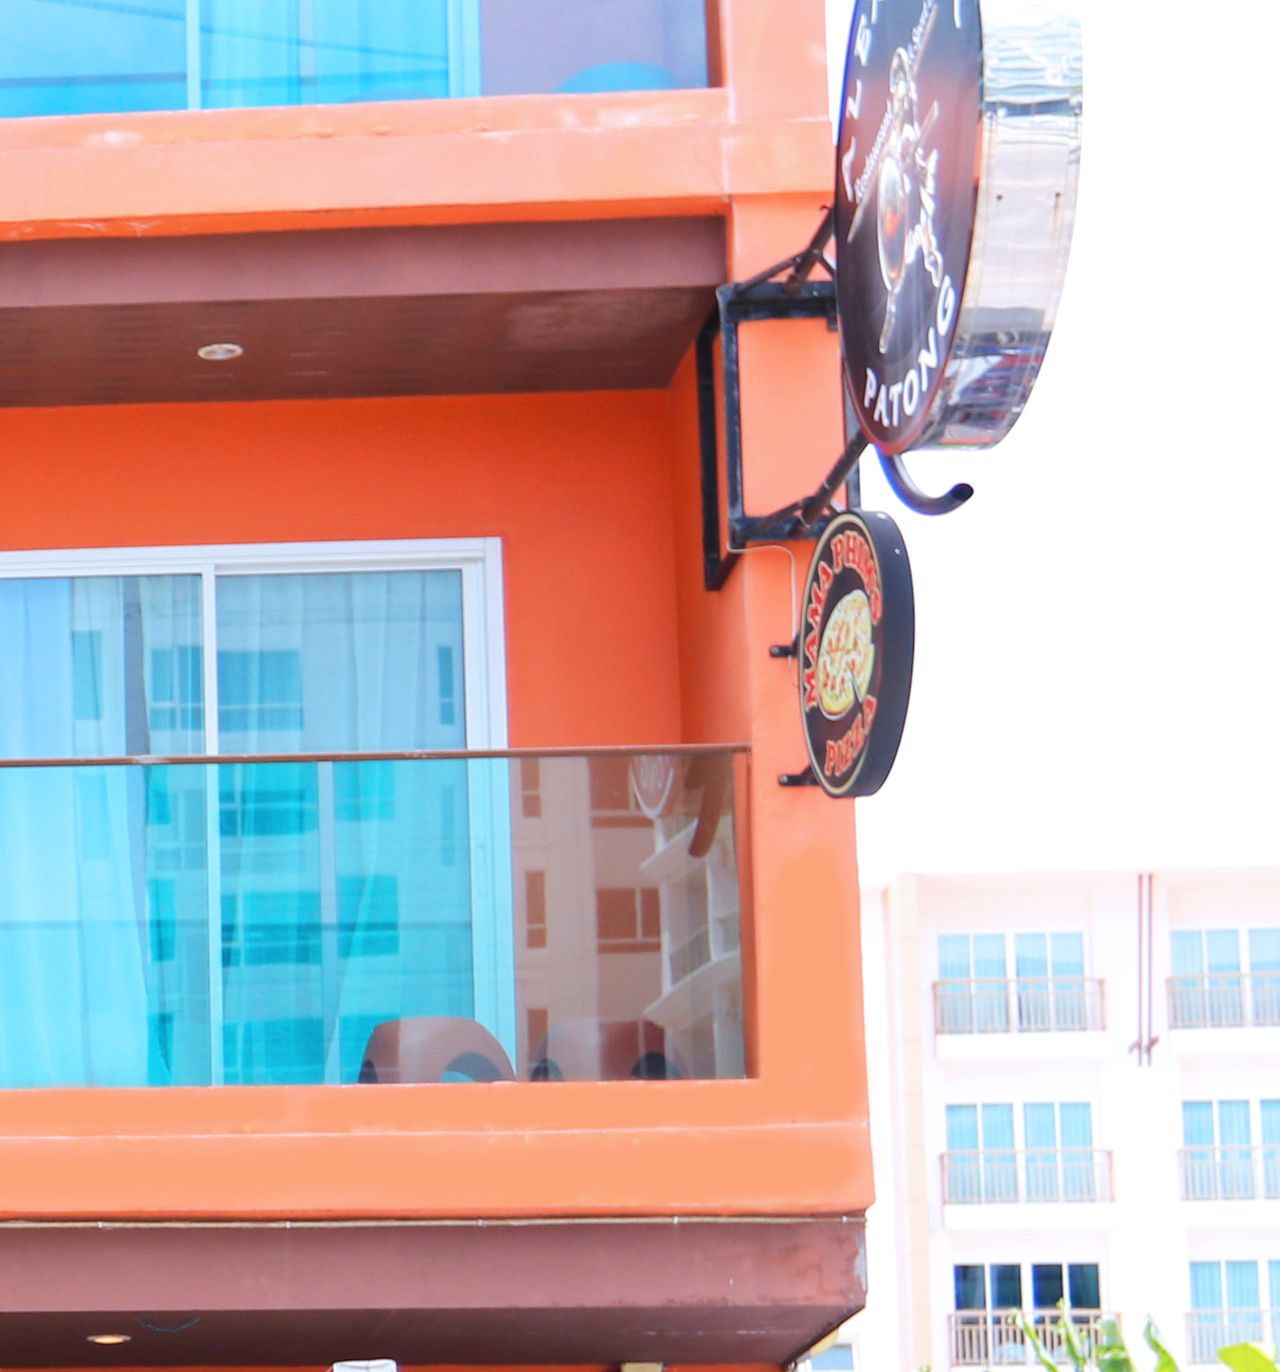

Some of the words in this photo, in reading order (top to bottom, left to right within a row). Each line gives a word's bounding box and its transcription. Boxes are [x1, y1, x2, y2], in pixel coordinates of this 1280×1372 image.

[863, 274, 955, 428] PATONG
[803, 560, 834, 712] MAMA
[824, 694, 878, 777] PIZZA
